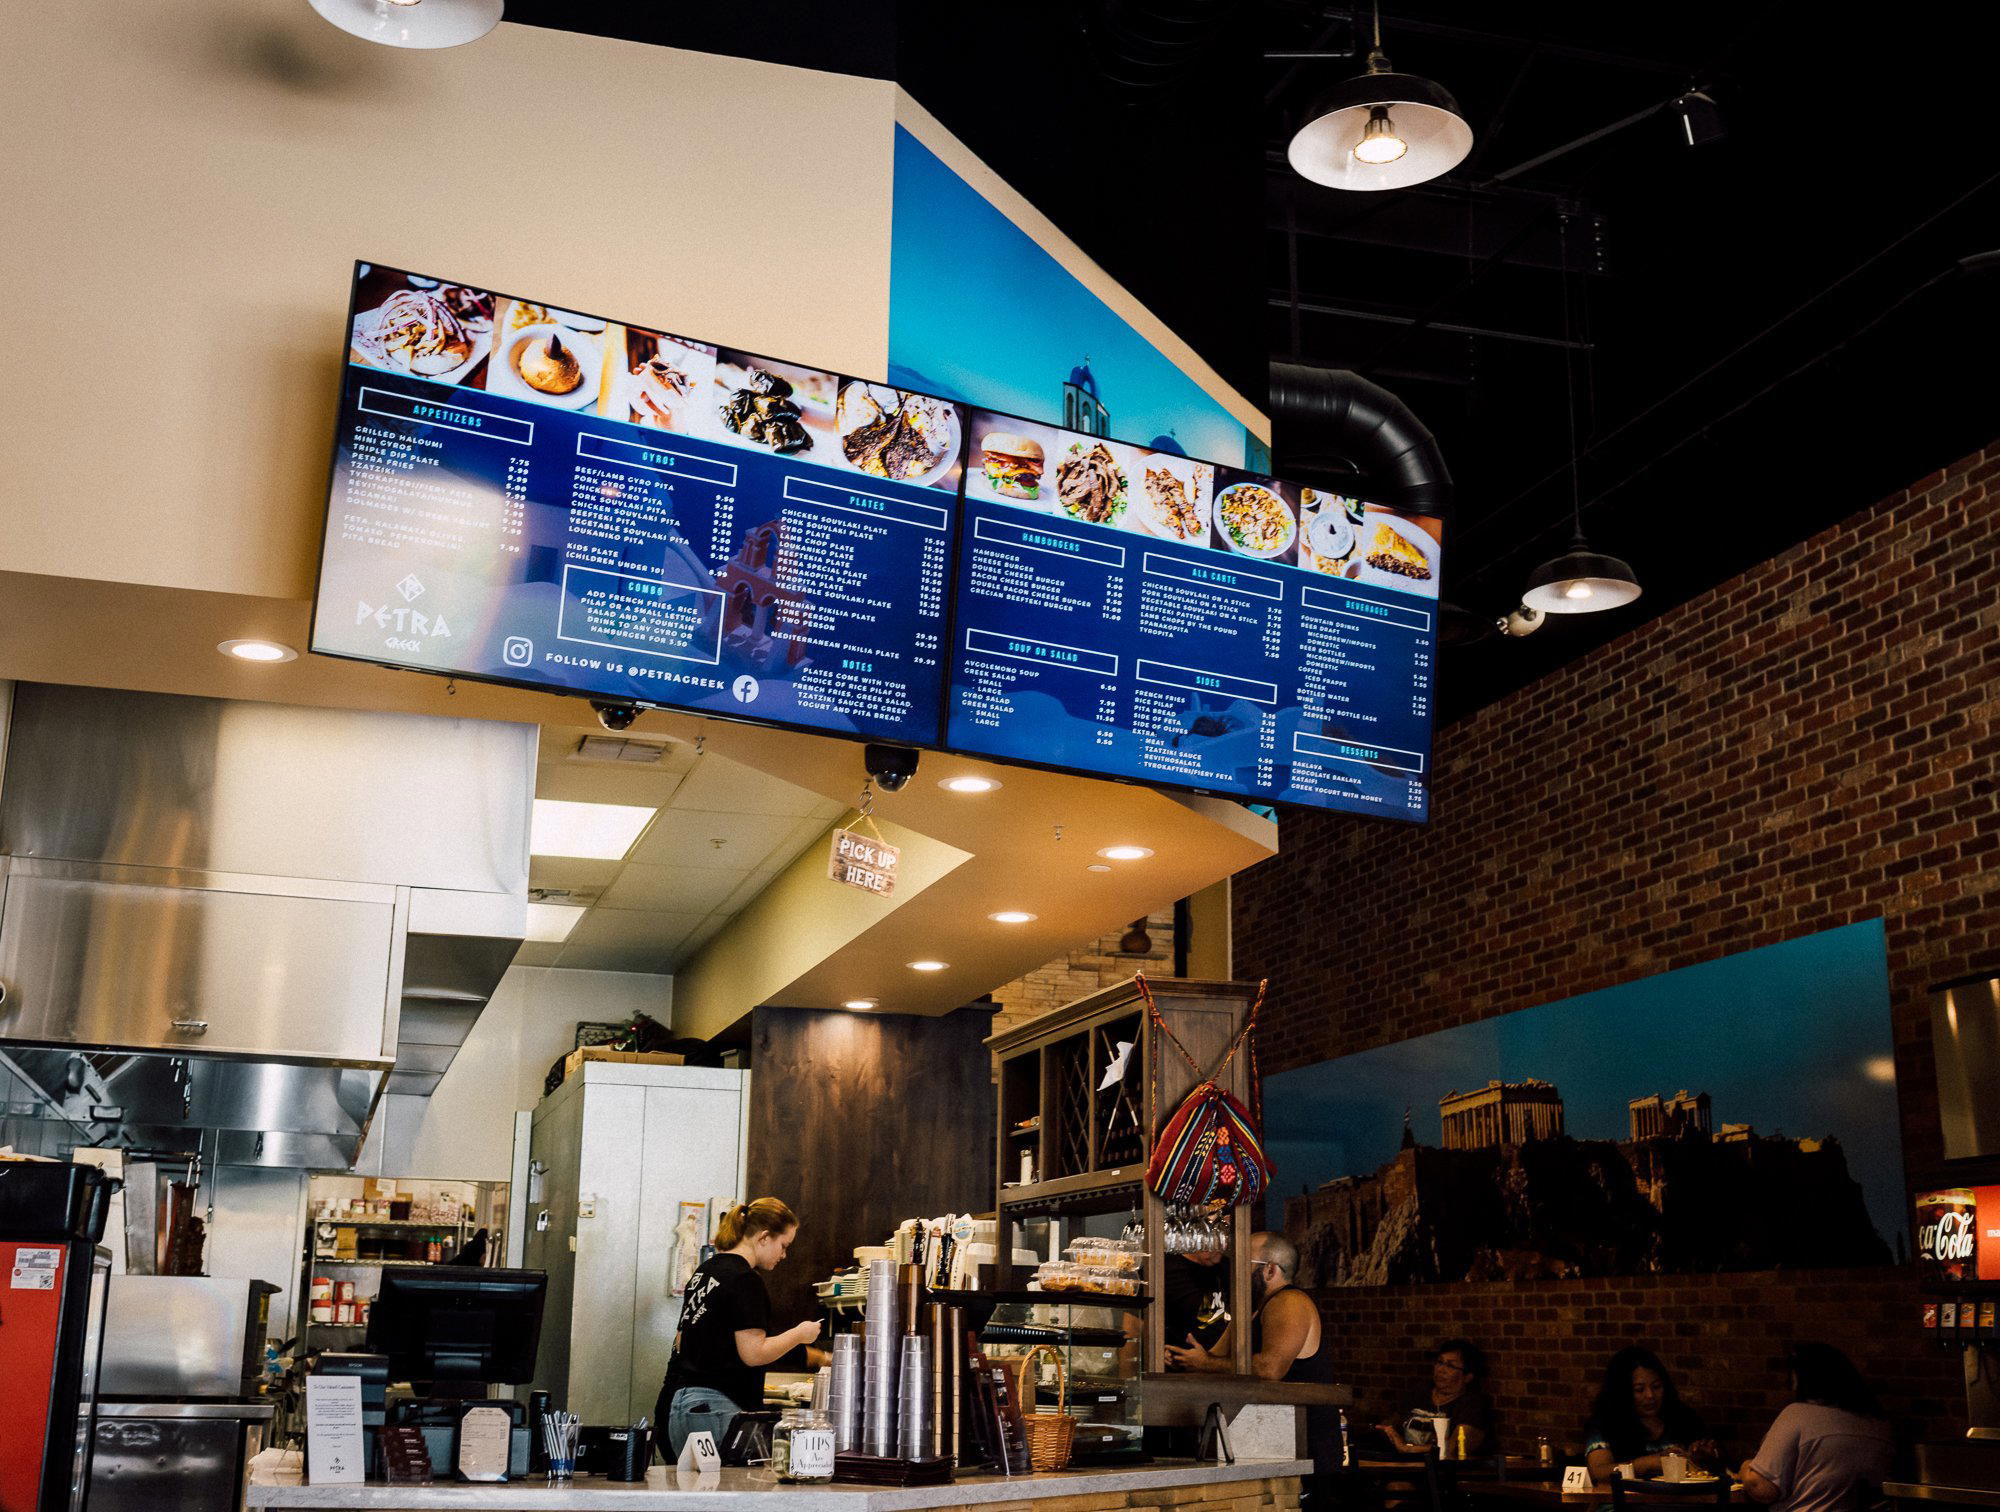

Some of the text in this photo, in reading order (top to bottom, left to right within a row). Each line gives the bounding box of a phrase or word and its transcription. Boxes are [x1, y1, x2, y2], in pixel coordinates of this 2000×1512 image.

[413, 405, 481, 427] APPETIZERS
[354, 434, 376, 444] MINI
[355, 426, 396, 439] GRILLED
[399, 435, 442, 448] HALOUMI
[352, 452, 414, 470] PETRA FRIES
[353, 443, 386, 456] TRIPLE
[389, 450, 407, 459] DIP
[410, 454, 439, 466] PLATE
[642, 451, 674, 466] GYROS
[351, 461, 393, 475] TZATZIKI
[574, 474, 598, 484] PORK
[628, 485, 648, 494] PITA
[715, 503, 734, 512] 9.50
[575, 466, 735, 503] BEEF/LAMB GYRO PITA 9.50
[642, 496, 662, 506] PITA
[714, 511, 733, 520] 9.50
[850, 496, 884, 511] PLATES
[570, 508, 731, 544] BEEFTEKI PITA 9.50
[571, 500, 731, 536] CHICKEN SOUVLAKI PITA 9.50
[781, 508, 945, 546] CHICKEN SOUVLAKI PLATE 15.50
[568, 525, 729, 561] LOUKANIKO PITA 9.50
[569, 517, 730, 553] VEGETABLE SOUVLAKI PITA 9.50
[1022, 533, 1079, 551] HAMBURGERS
[567, 542, 588, 552] KIDS
[591, 547, 618, 558] PLATE
[779, 532, 943, 570] LAMB CHOP PLATE 24.50
[973, 548, 1020, 562] HAMBURGER
[566, 551, 614, 565] (CHILDREN
[617, 561, 648, 571] UNDER
[972, 555, 1034, 572] CHEESE BURGER
[628, 582, 663, 596] COMBO
[777, 565, 941, 602] SPANAKOPITA PLATE 15.50
[971, 571, 997, 581] BACON
[999, 577, 1028, 587] CHEESE
[1031, 583, 1061, 593] BURGER
[586, 590, 697, 615] ADD FRENCH FRIES, RICE
[775, 582, 939, 618] VEGETABLE SOUVLAKI PLATE 15.50
[1141, 588, 1161, 597] PORK
[1163, 593, 1197, 604] SOUVLAKI
[1219, 604, 1238, 613] STICK
[1346, 600, 1388, 616] BEVERAGES
[357, 601, 450, 637] PETRA
[774, 598, 875, 622] ATHENIAN PIKILIA PLATE
[1140, 619, 1188, 633] SPANAKOPITA
[1301, 614, 1359, 631] FOUNTAIN DRINKS
[590, 625, 645, 640] HAMBURGER
[648, 635, 666, 644] FOR
[771, 631, 935, 665] MEDITERRANEAN PIKILIA PLATE 29.99
[1009, 642, 1031, 653] SOUP
[1050, 650, 1077, 662] SALAD
[545, 653, 724, 689] FOLLOW US @PETRAGREEK
[842, 659, 872, 672] NOTES
[1019, 669, 1039, 677] SOUP
[1298, 666, 1322, 675] COFFEE
[803, 667, 906, 689] PLATES COME WITH YOUR
[1196, 676, 1220, 687] SIDES
[985, 695, 1010, 704] SALAD
[1297, 688, 1350, 702] BOTTLED WATER
[1133, 704, 1150, 712] PITA
[1152, 708, 1176, 717] BREAD
[1133, 712, 1150, 720] SIDE
[1163, 717, 1181, 725] FETA
[1340, 745, 1378, 759] DESSERTS
[1292, 760, 1322, 770] BAKLAVA
[1292, 768, 1361, 784] CHOCOLATE BAKLAVA
[1291, 783, 1313, 791] GREEK
[1342, 791, 1359, 799] WITH
[1360, 794, 1382, 802] HONEY
[840, 839, 897, 870] PICK UP
[845, 865, 883, 891] HERE
[697, 1438, 715, 1458] 30
[804, 1436, 831, 1451] TIPS
[1567, 1471, 1582, 1484] 41
